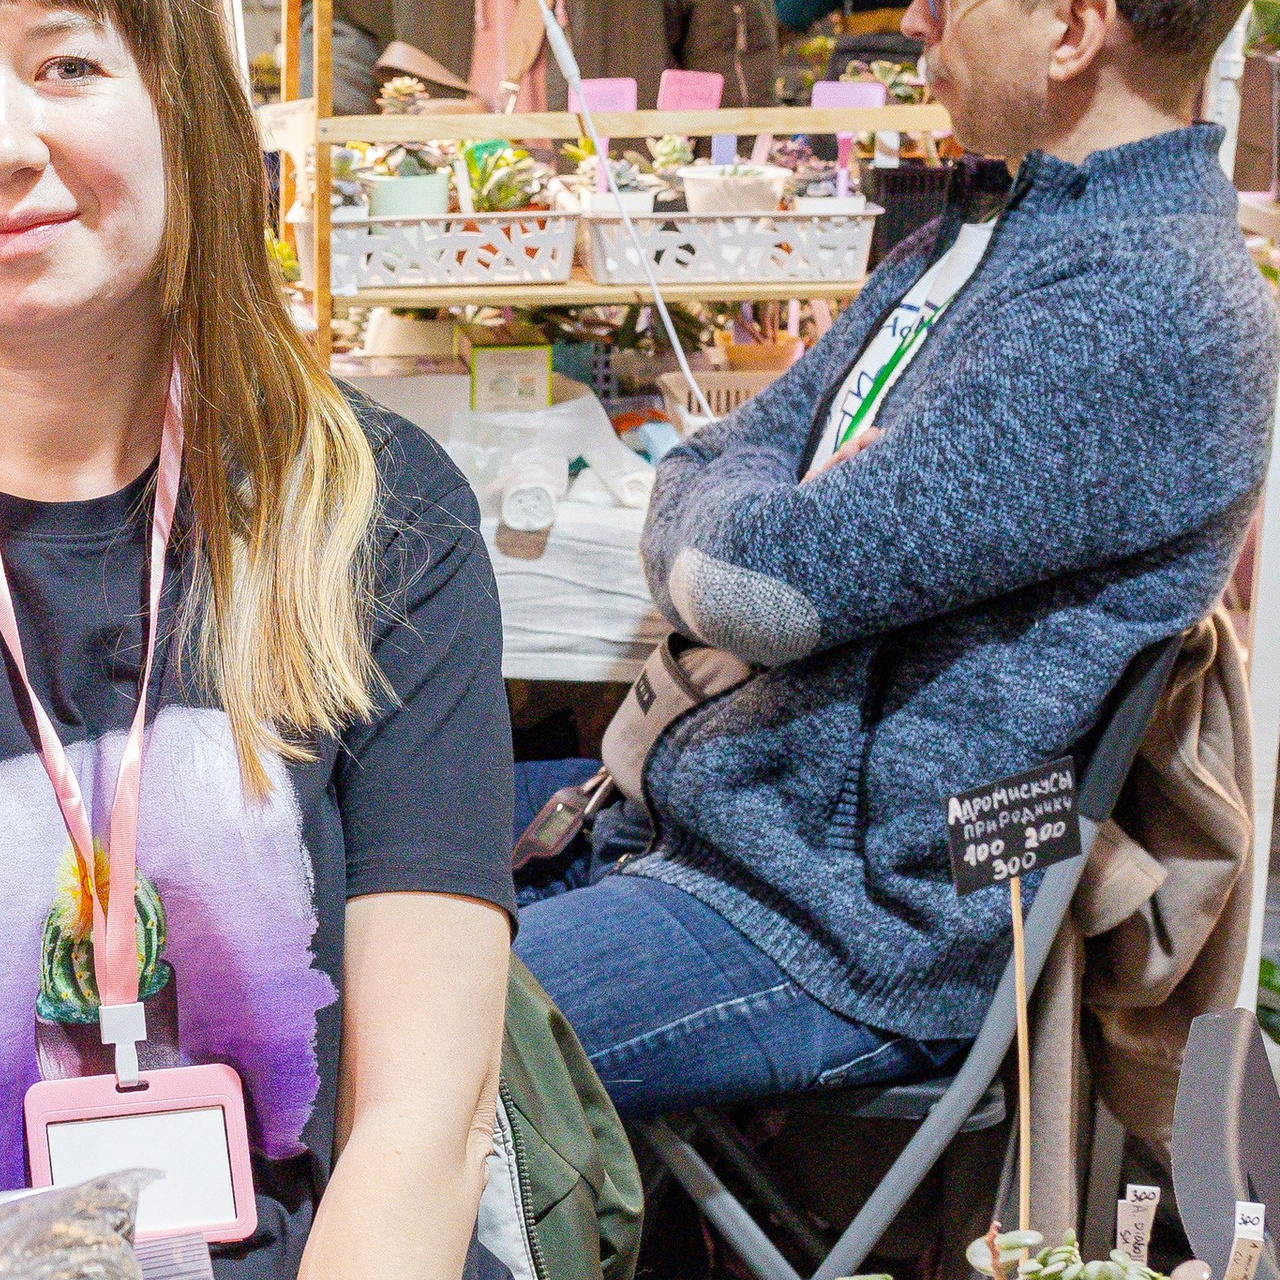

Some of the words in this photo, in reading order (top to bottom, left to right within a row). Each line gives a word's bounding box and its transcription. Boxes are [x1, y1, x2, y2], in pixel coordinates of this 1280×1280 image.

[963, 838, 1006, 867] 100
[1024, 821, 1067, 849] 200
[991, 851, 1037, 881] 300
[1131, 1189, 1156, 1203] 300
[1238, 1213, 1261, 1227] 300
